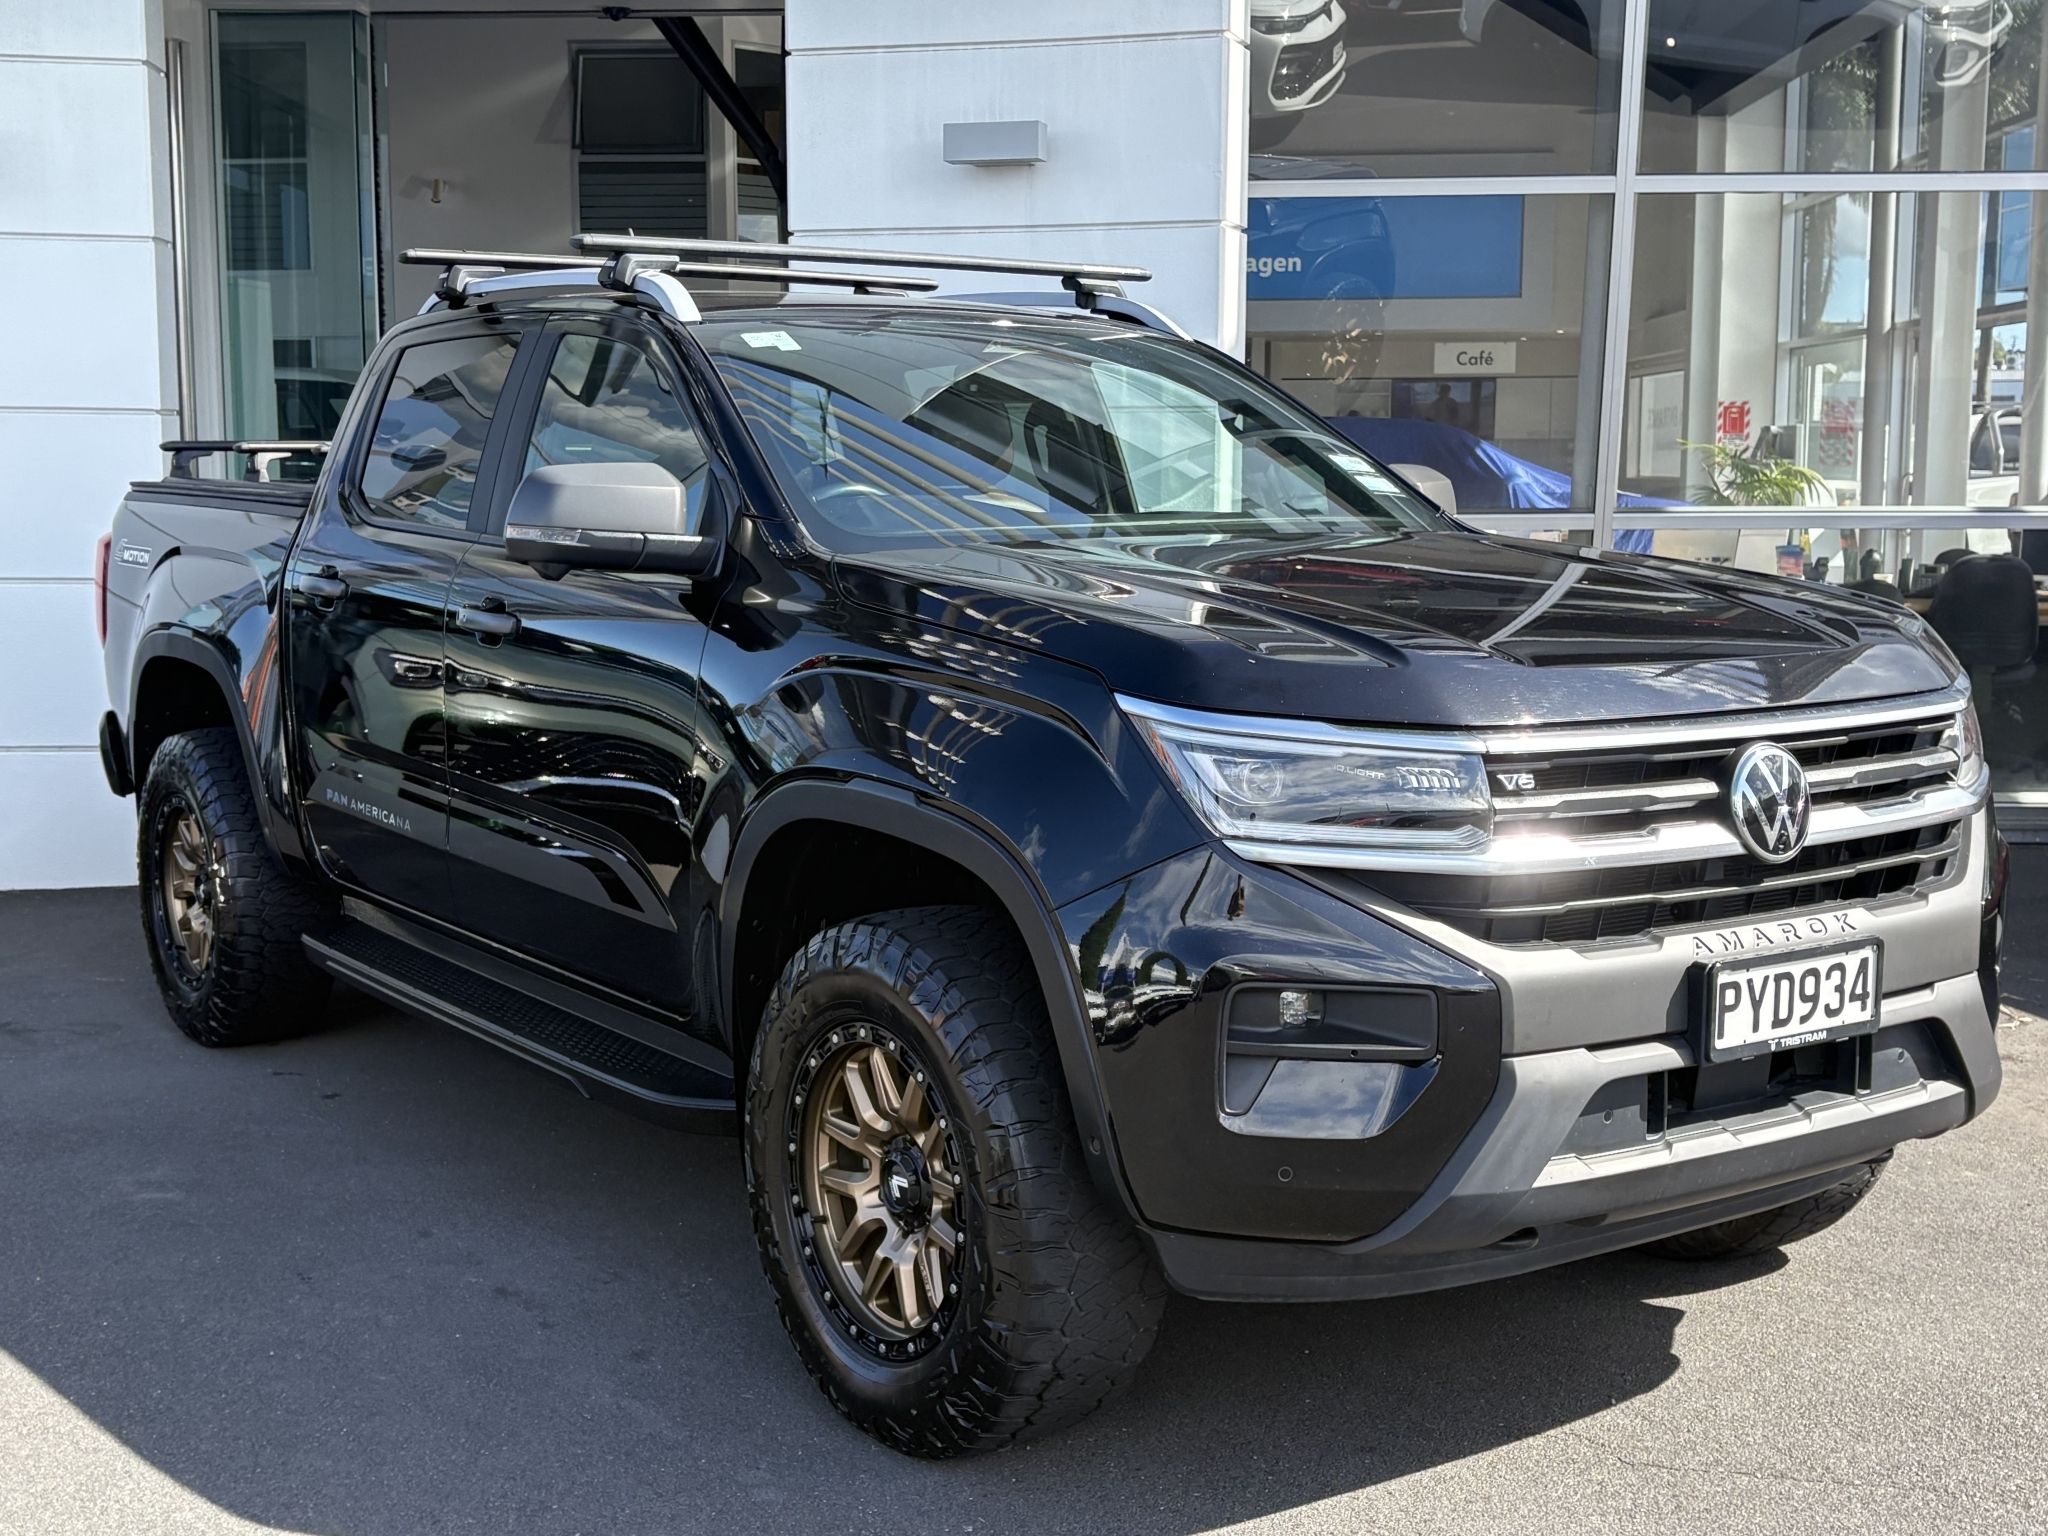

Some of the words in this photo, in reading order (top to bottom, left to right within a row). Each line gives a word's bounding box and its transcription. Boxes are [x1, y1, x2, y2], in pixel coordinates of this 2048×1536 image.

[1456, 350, 1494, 366] Café
[1496, 773, 1535, 790] V6
[326, 788, 348, 807] PAN
[350, 798, 411, 832] AMERICANA
[1692, 913, 1858, 957] AMAROK
[1716, 956, 1870, 1041] PYD934
[1780, 1030, 1827, 1047] TRISTRAM
